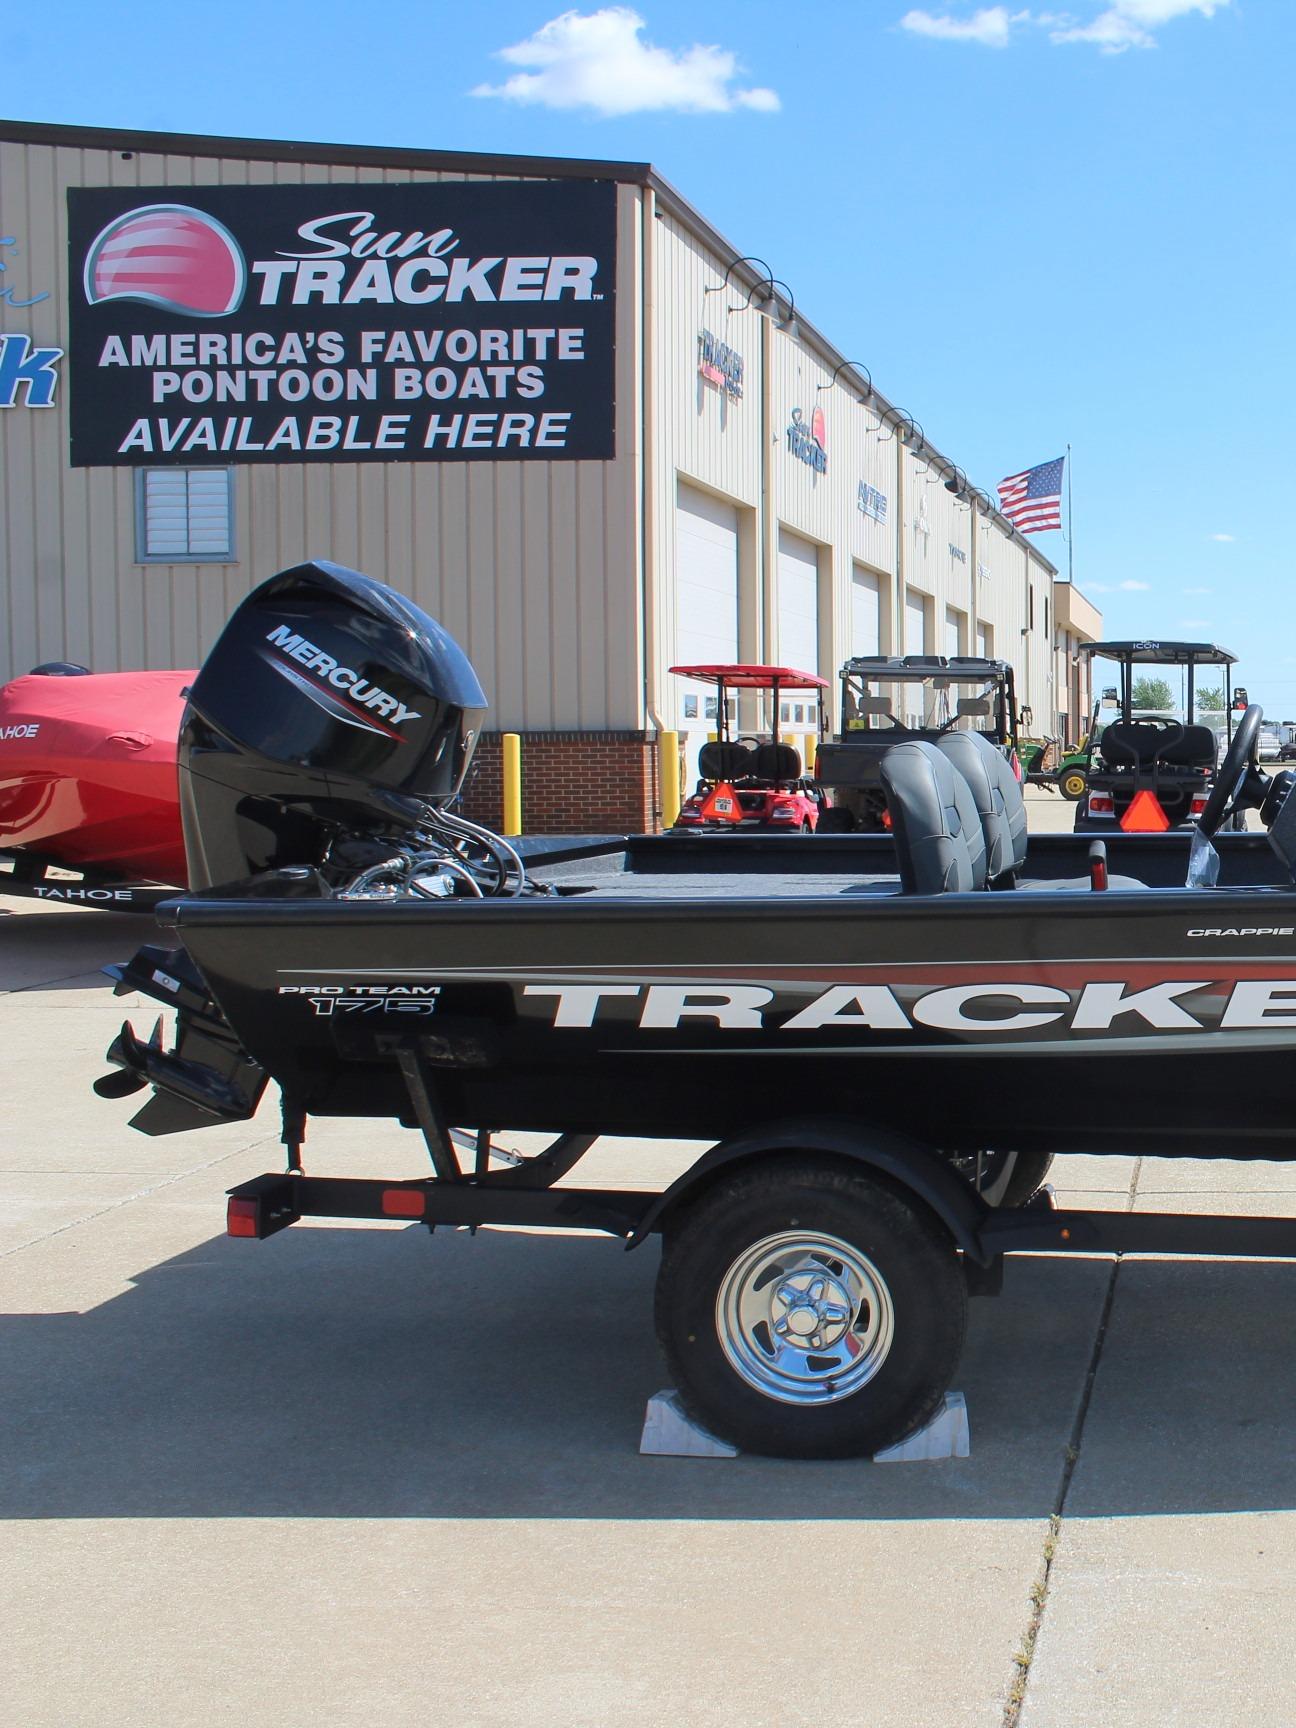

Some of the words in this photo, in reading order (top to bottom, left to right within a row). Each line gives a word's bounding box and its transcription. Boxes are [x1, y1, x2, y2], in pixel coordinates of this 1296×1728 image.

[274, 212, 459, 258] Sun
[251, 256, 598, 305] TRACKER
[98, 331, 345, 367] AMERICA'S
[361, 328, 585, 362] FAVORITE
[152, 368, 378, 403] PONTOON
[394, 365, 545, 399] BOATS
[118, 414, 411, 452] AVAILABLE
[424, 412, 572, 449] HERE
[266, 624, 422, 724] MERCURY
[33, 887, 132, 900] TAHOE
[1187, 927, 1294, 937] CRAPPIE
[278, 986, 343, 994] PRO
[349, 986, 441, 994] TEAM
[308, 997, 435, 1015] 175
